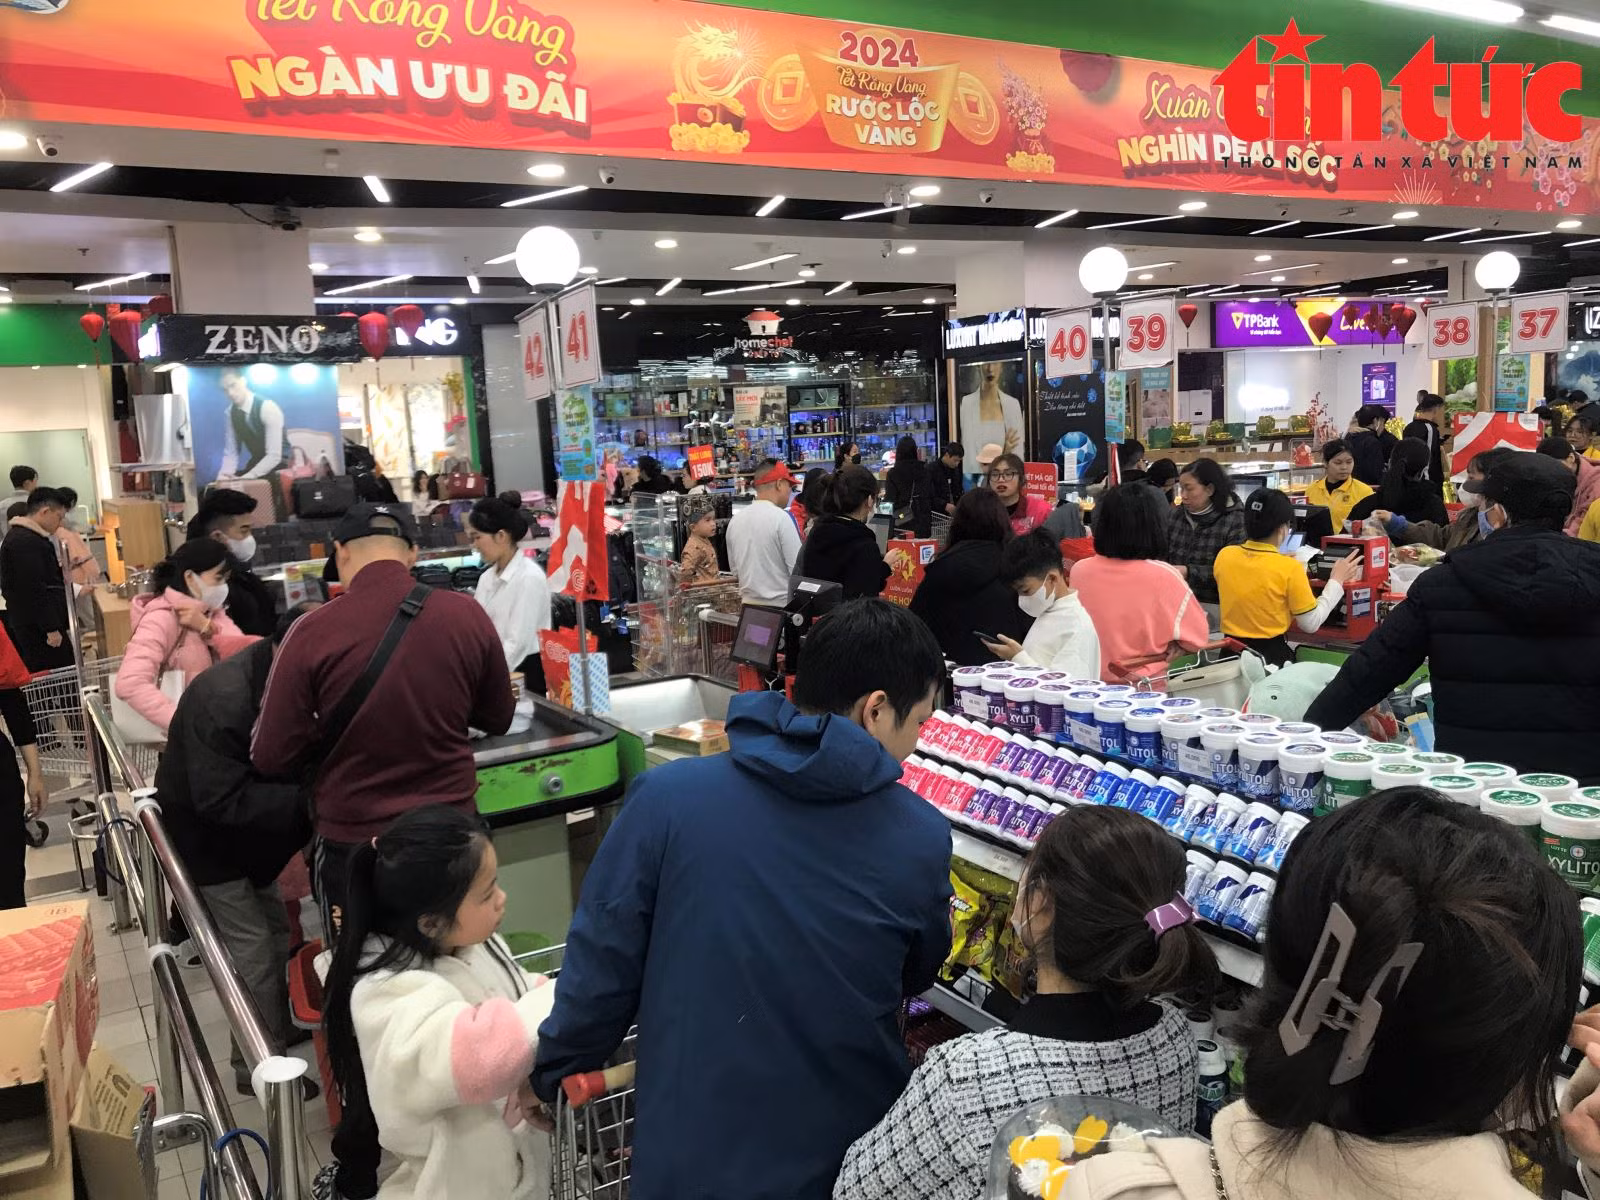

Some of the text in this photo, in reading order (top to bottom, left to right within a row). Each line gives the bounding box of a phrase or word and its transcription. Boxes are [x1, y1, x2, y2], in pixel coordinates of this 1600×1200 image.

[840, 31, 919, 68] 2024
[229, 46, 587, 124] NGÀN ƯU ĐÃI
[837, 66, 857, 88] Tết
[896, 75, 927, 97] Vàng
[826, 94, 941, 127] RƯỚC LỘC
[1144, 80, 1211, 120] Xuân
[854, 121, 917, 147] VÀNG
[1118, 127, 1207, 168] NGHÌN
[565, 310, 590, 364] 41
[1127, 313, 1168, 353] 39
[1244, 314, 1279, 328] TPBank
[1433, 316, 1471, 347] 38
[1518, 307, 1560, 340] 37
[205, 325, 320, 354] ZENO
[524, 332, 545, 380] 42
[1050, 324, 1088, 362] 40
[692, 462, 714, 479] 150K
[1548, 854, 1600, 875] XYLITO
